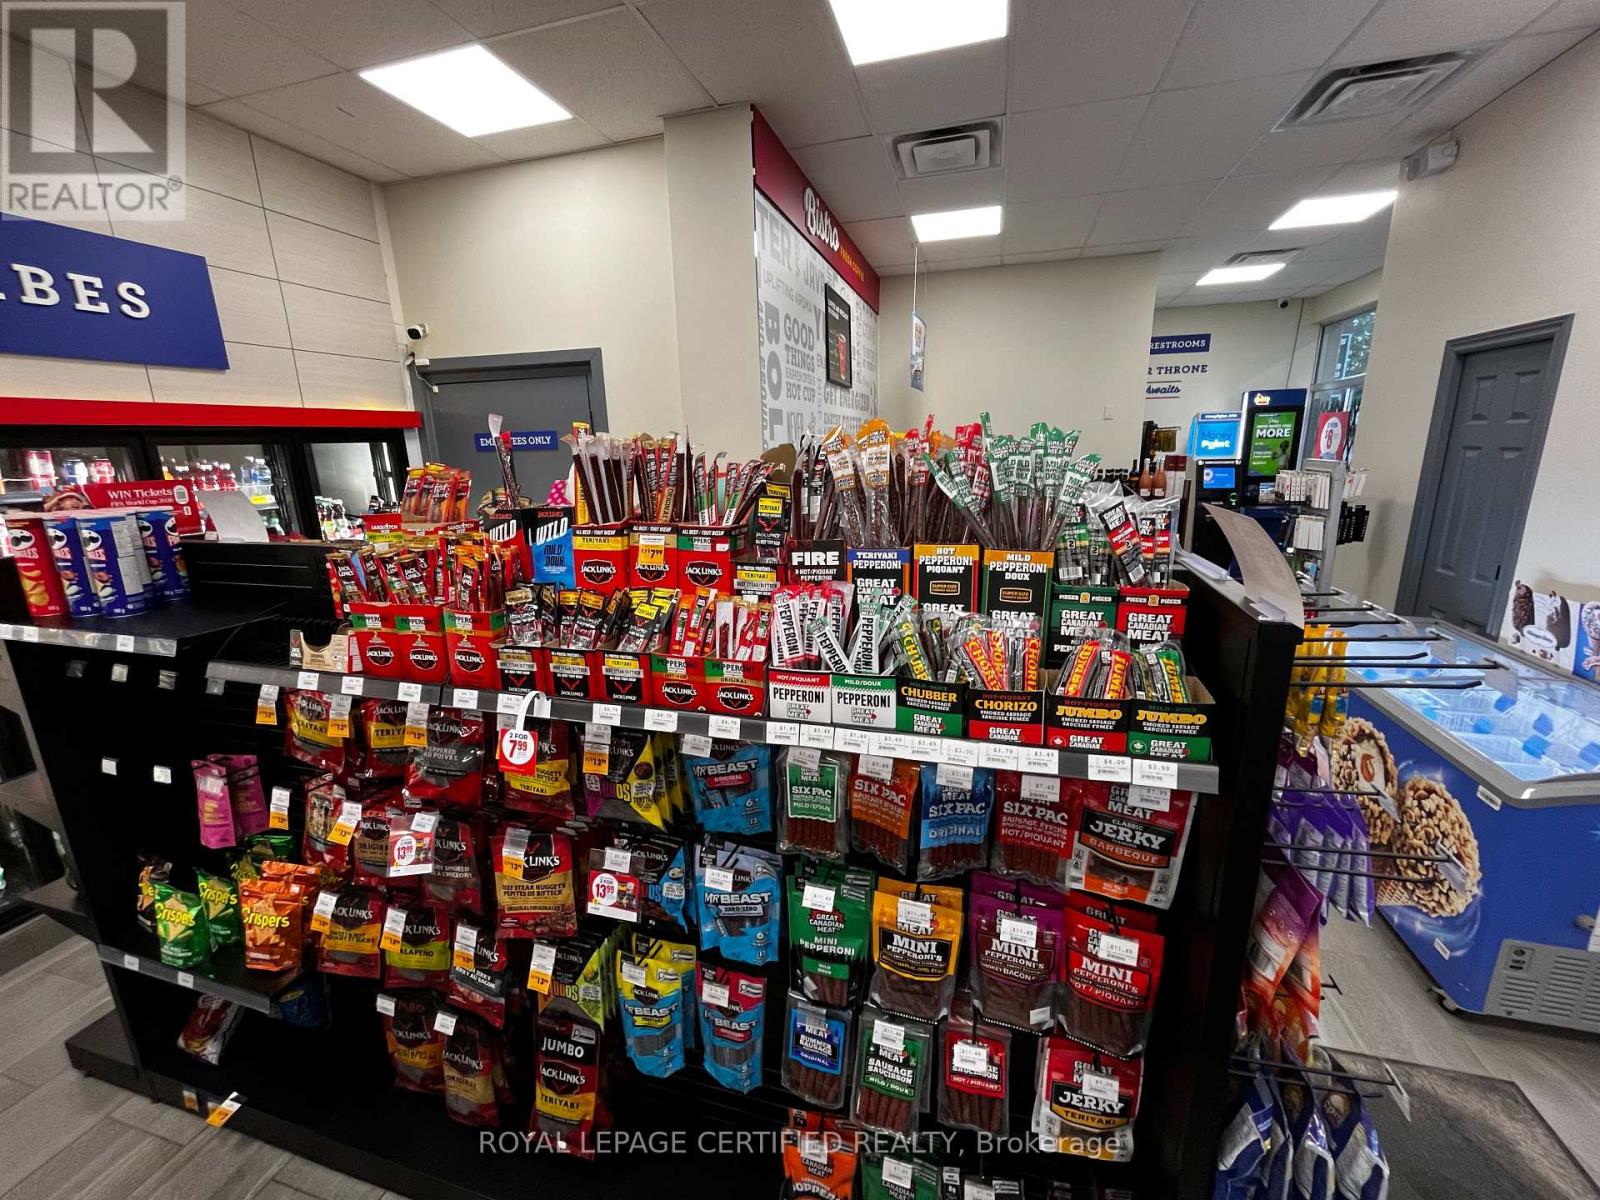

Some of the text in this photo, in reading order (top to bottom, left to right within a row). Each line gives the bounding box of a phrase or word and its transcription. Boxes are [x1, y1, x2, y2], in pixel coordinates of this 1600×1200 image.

[804, 187, 840, 252] Bistro
[0, 263, 151, 319] BES
[784, 313, 814, 351] GOOD
[785, 343, 815, 373] THINGS
[1157, 365, 1208, 375] THRONE
[528, 436, 551, 445] ONLY
[1256, 428, 1291, 438] MORE
[108, 488, 173, 499] WIN Tickets
[537, 518, 568, 545] WILD
[791, 552, 839, 565] FIRE
[852, 560, 902, 569] PEPPERONI
[919, 556, 973, 566] PEPPERONI
[1006, 553, 1031, 561] MILD
[989, 562, 1047, 573] PEPPERONI
[856, 578, 896, 588] GREAT
[923, 603, 964, 612] GREAT
[991, 610, 1035, 620] GREAT
[1061, 610, 1104, 620] GREAT
[1061, 619, 1099, 627] CANADIAN
[1128, 613, 1173, 623] GREAT
[779, 603, 799, 656] PEPPERONI
[1128, 622, 1170, 631] CANADIAN
[1127, 630, 1171, 641] MEAT
[866, 616, 874, 672] PEPPERONI
[773, 687, 824, 704] PEPPERONI
[837, 692, 891, 708] PEPPERONI
[901, 686, 958, 702] CHUBBER
[975, 699, 1038, 711] CHORIZO
[1056, 705, 1122, 720] JUMBO
[914, 714, 943, 723] GREAT
[1136, 710, 1207, 725] JUMBO
[914, 726, 943, 735] MEAT
[989, 727, 1022, 736] GREAT
[1069, 735, 1104, 744] GREAT
[1151, 739, 1187, 748] GREAT
[707, 760, 758, 775] BEAST
[792, 786, 832, 798] SIX PAC
[855, 779, 906, 806] SIX PAC
[928, 801, 986, 817] SIX PAC
[1003, 801, 1068, 826] SIX PAC
[1108, 801, 1154, 820] MEAT
[1112, 819, 1144, 831] CLASSIC
[928, 827, 981, 839] ORIGINAL
[1001, 828, 1066, 848] HOT/PIQUANT
[1090, 820, 1166, 850] JERKY
[1089, 838, 1159, 865] BARBEQUE
[199, 883, 238, 905] Crispers
[704, 892, 772, 904] MR BEAST
[155, 904, 196, 927] Crispers
[242, 909, 290, 928] Crispers
[897, 924, 934, 935] MEAT
[800, 939, 855, 956] PEPPERONI
[814, 937, 837, 945] MINI
[893, 935, 937, 954] MINI
[887, 945, 942, 961] PEPPERONI'S
[992, 939, 1039, 961] MINI
[985, 950, 1045, 969] PEPPERONI'S
[1003, 968, 1032, 981] BACON
[1081, 957, 1134, 983] MINI
[1074, 968, 1139, 994] PEPPERONI'S
[634, 1002, 678, 1018] BEAST
[714, 1018, 758, 1031] BEAST
[541, 1037, 584, 1058] JUMBO
[879, 1050, 904, 1063] MEAT
[868, 1058, 913, 1077] SAUSAGE
[868, 1065, 912, 1084] SAUCISSON
[540, 1096, 580, 1110] TERIYAKI
[1059, 1091, 1124, 1114] JERKY
[1064, 1110, 1116, 1126] TERIYAKI
